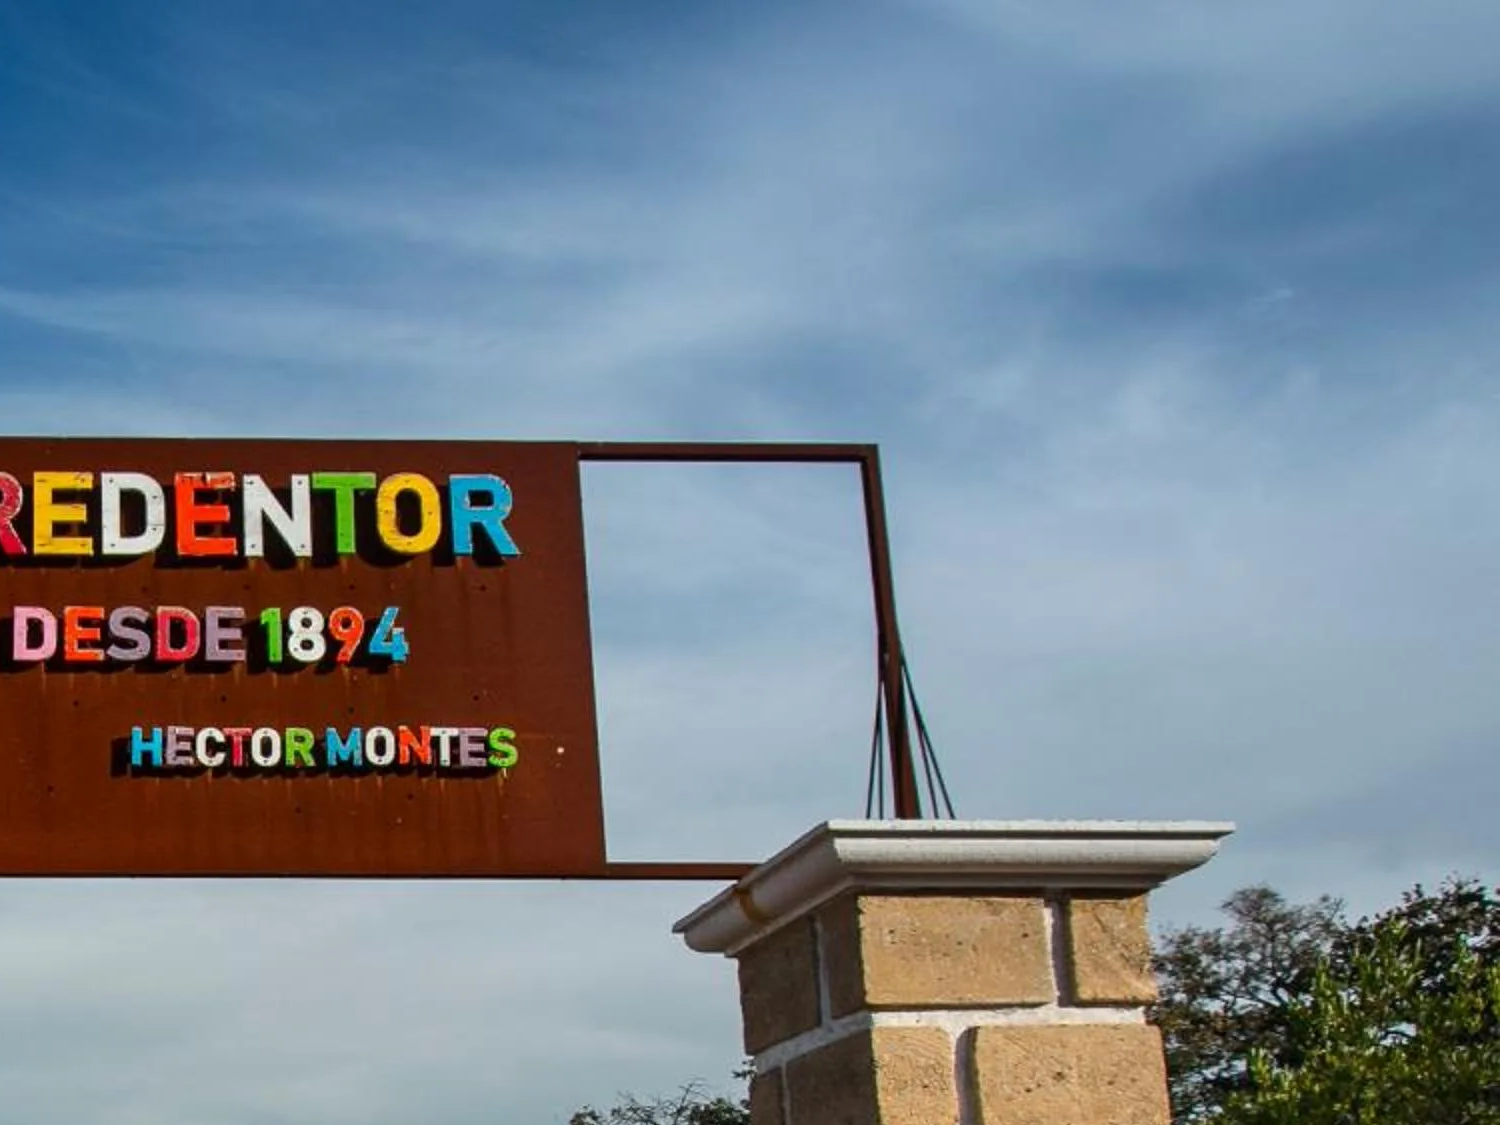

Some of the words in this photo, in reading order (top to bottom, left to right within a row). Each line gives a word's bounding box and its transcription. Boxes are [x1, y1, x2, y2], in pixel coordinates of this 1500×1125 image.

[13, 606, 246, 662] DESDE
[260, 606, 410, 663] 1894
[131, 726, 316, 767] HECTOR
[326, 725, 518, 768] MONTES
